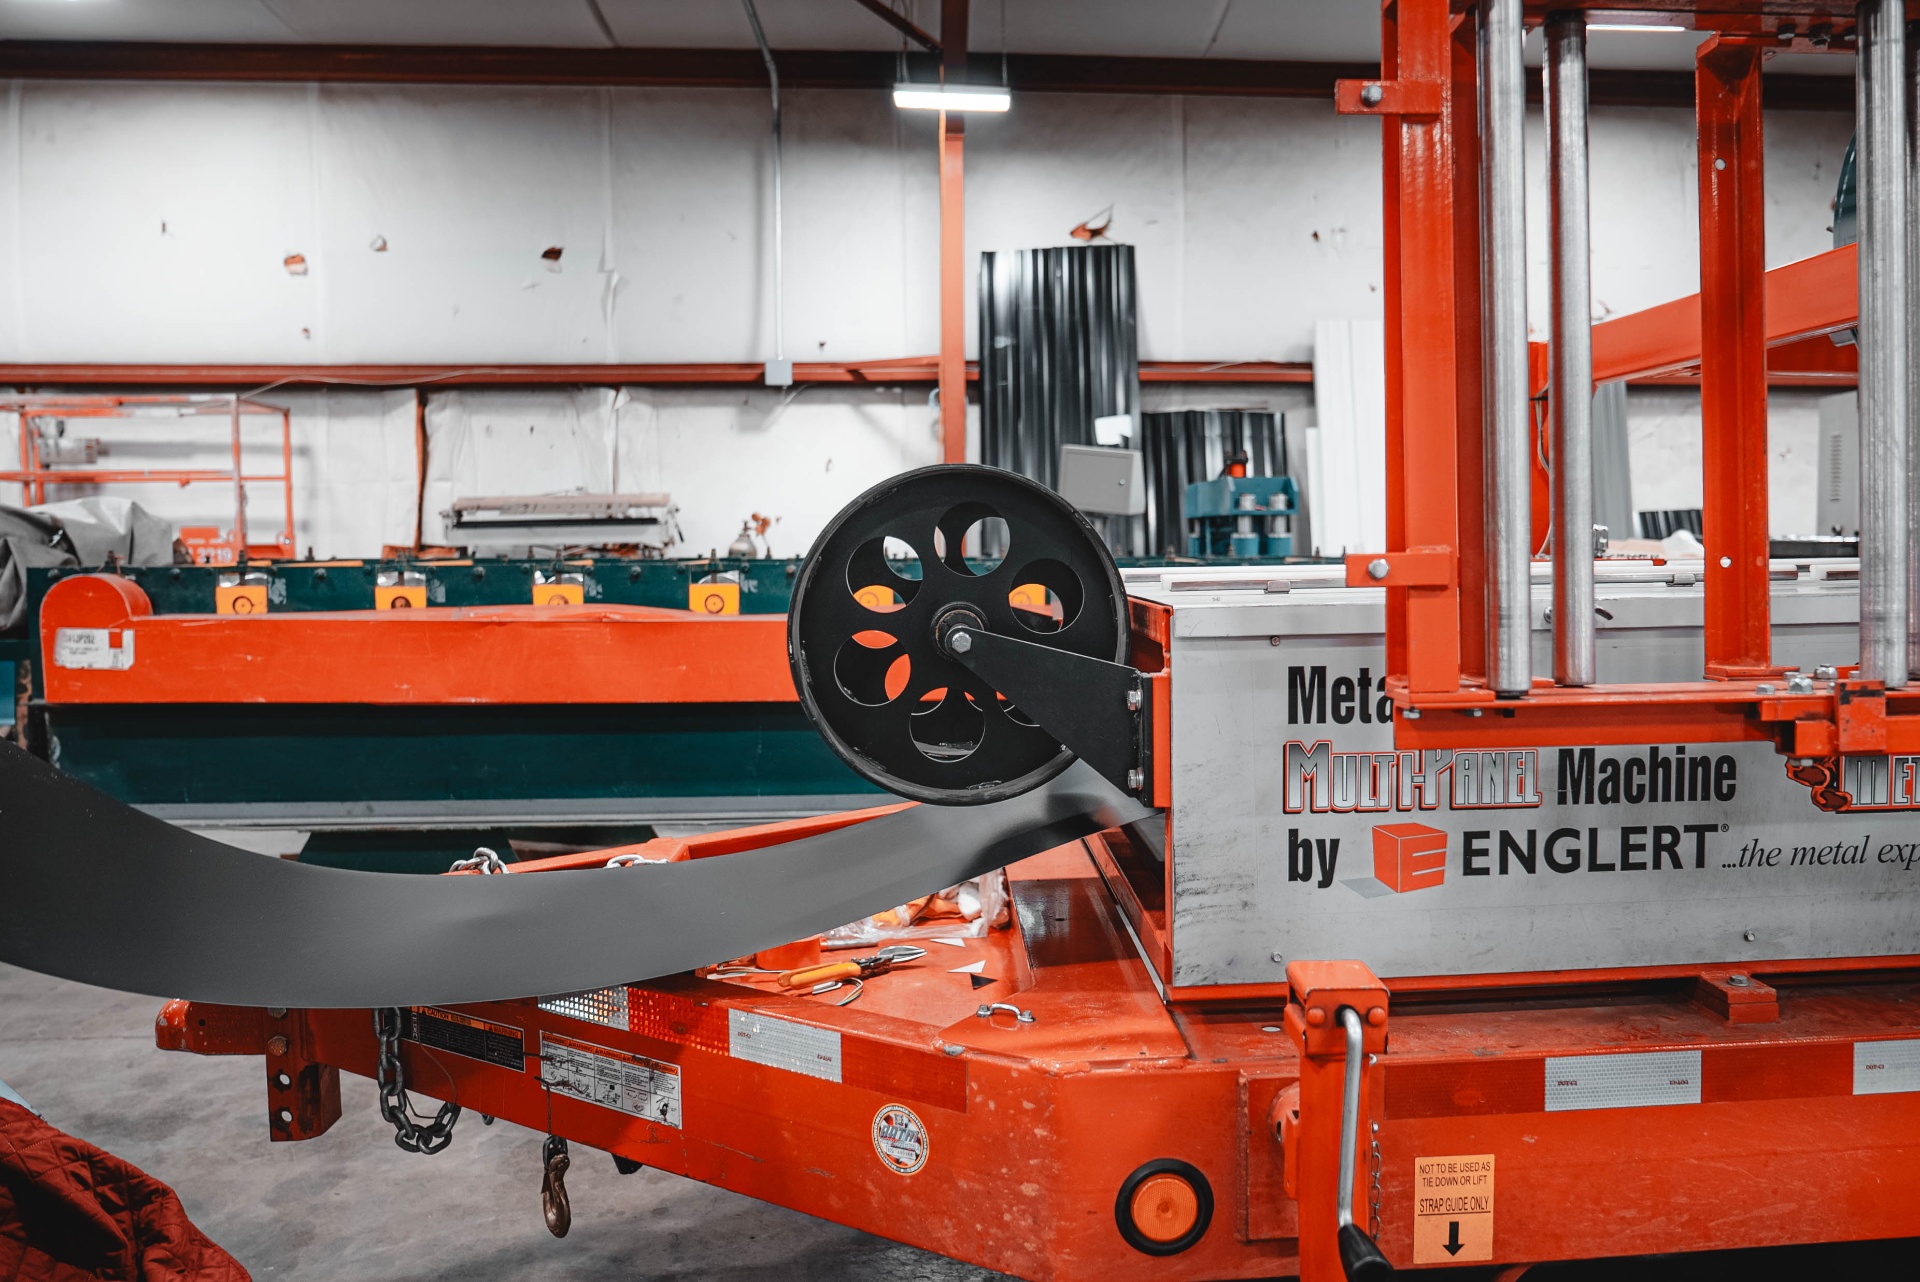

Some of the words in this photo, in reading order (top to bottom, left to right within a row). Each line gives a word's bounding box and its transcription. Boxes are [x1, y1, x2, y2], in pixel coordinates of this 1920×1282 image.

[1557, 745, 1737, 806] Machine
[1288, 828, 1340, 889] by
[1790, 834, 1871, 867] metal
[1419, 1164, 1435, 1174] NOT
[1437, 1163, 1446, 1173] TO
[1448, 1163, 1457, 1173] BE
[1460, 1162, 1479, 1173] USED
[1481, 1161, 1491, 1172] AS
[1422, 1177, 1434, 1187] TIE
[1435, 1176, 1459, 1187] DOWN
[1460, 1175, 1471, 1186] OR
[1472, 1175, 1488, 1185] LIFT
[1419, 1198, 1444, 1213] STRAP
[1445, 1196, 1468, 1212] GUIDE
[1470, 1195, 1490, 1211] ONLY
